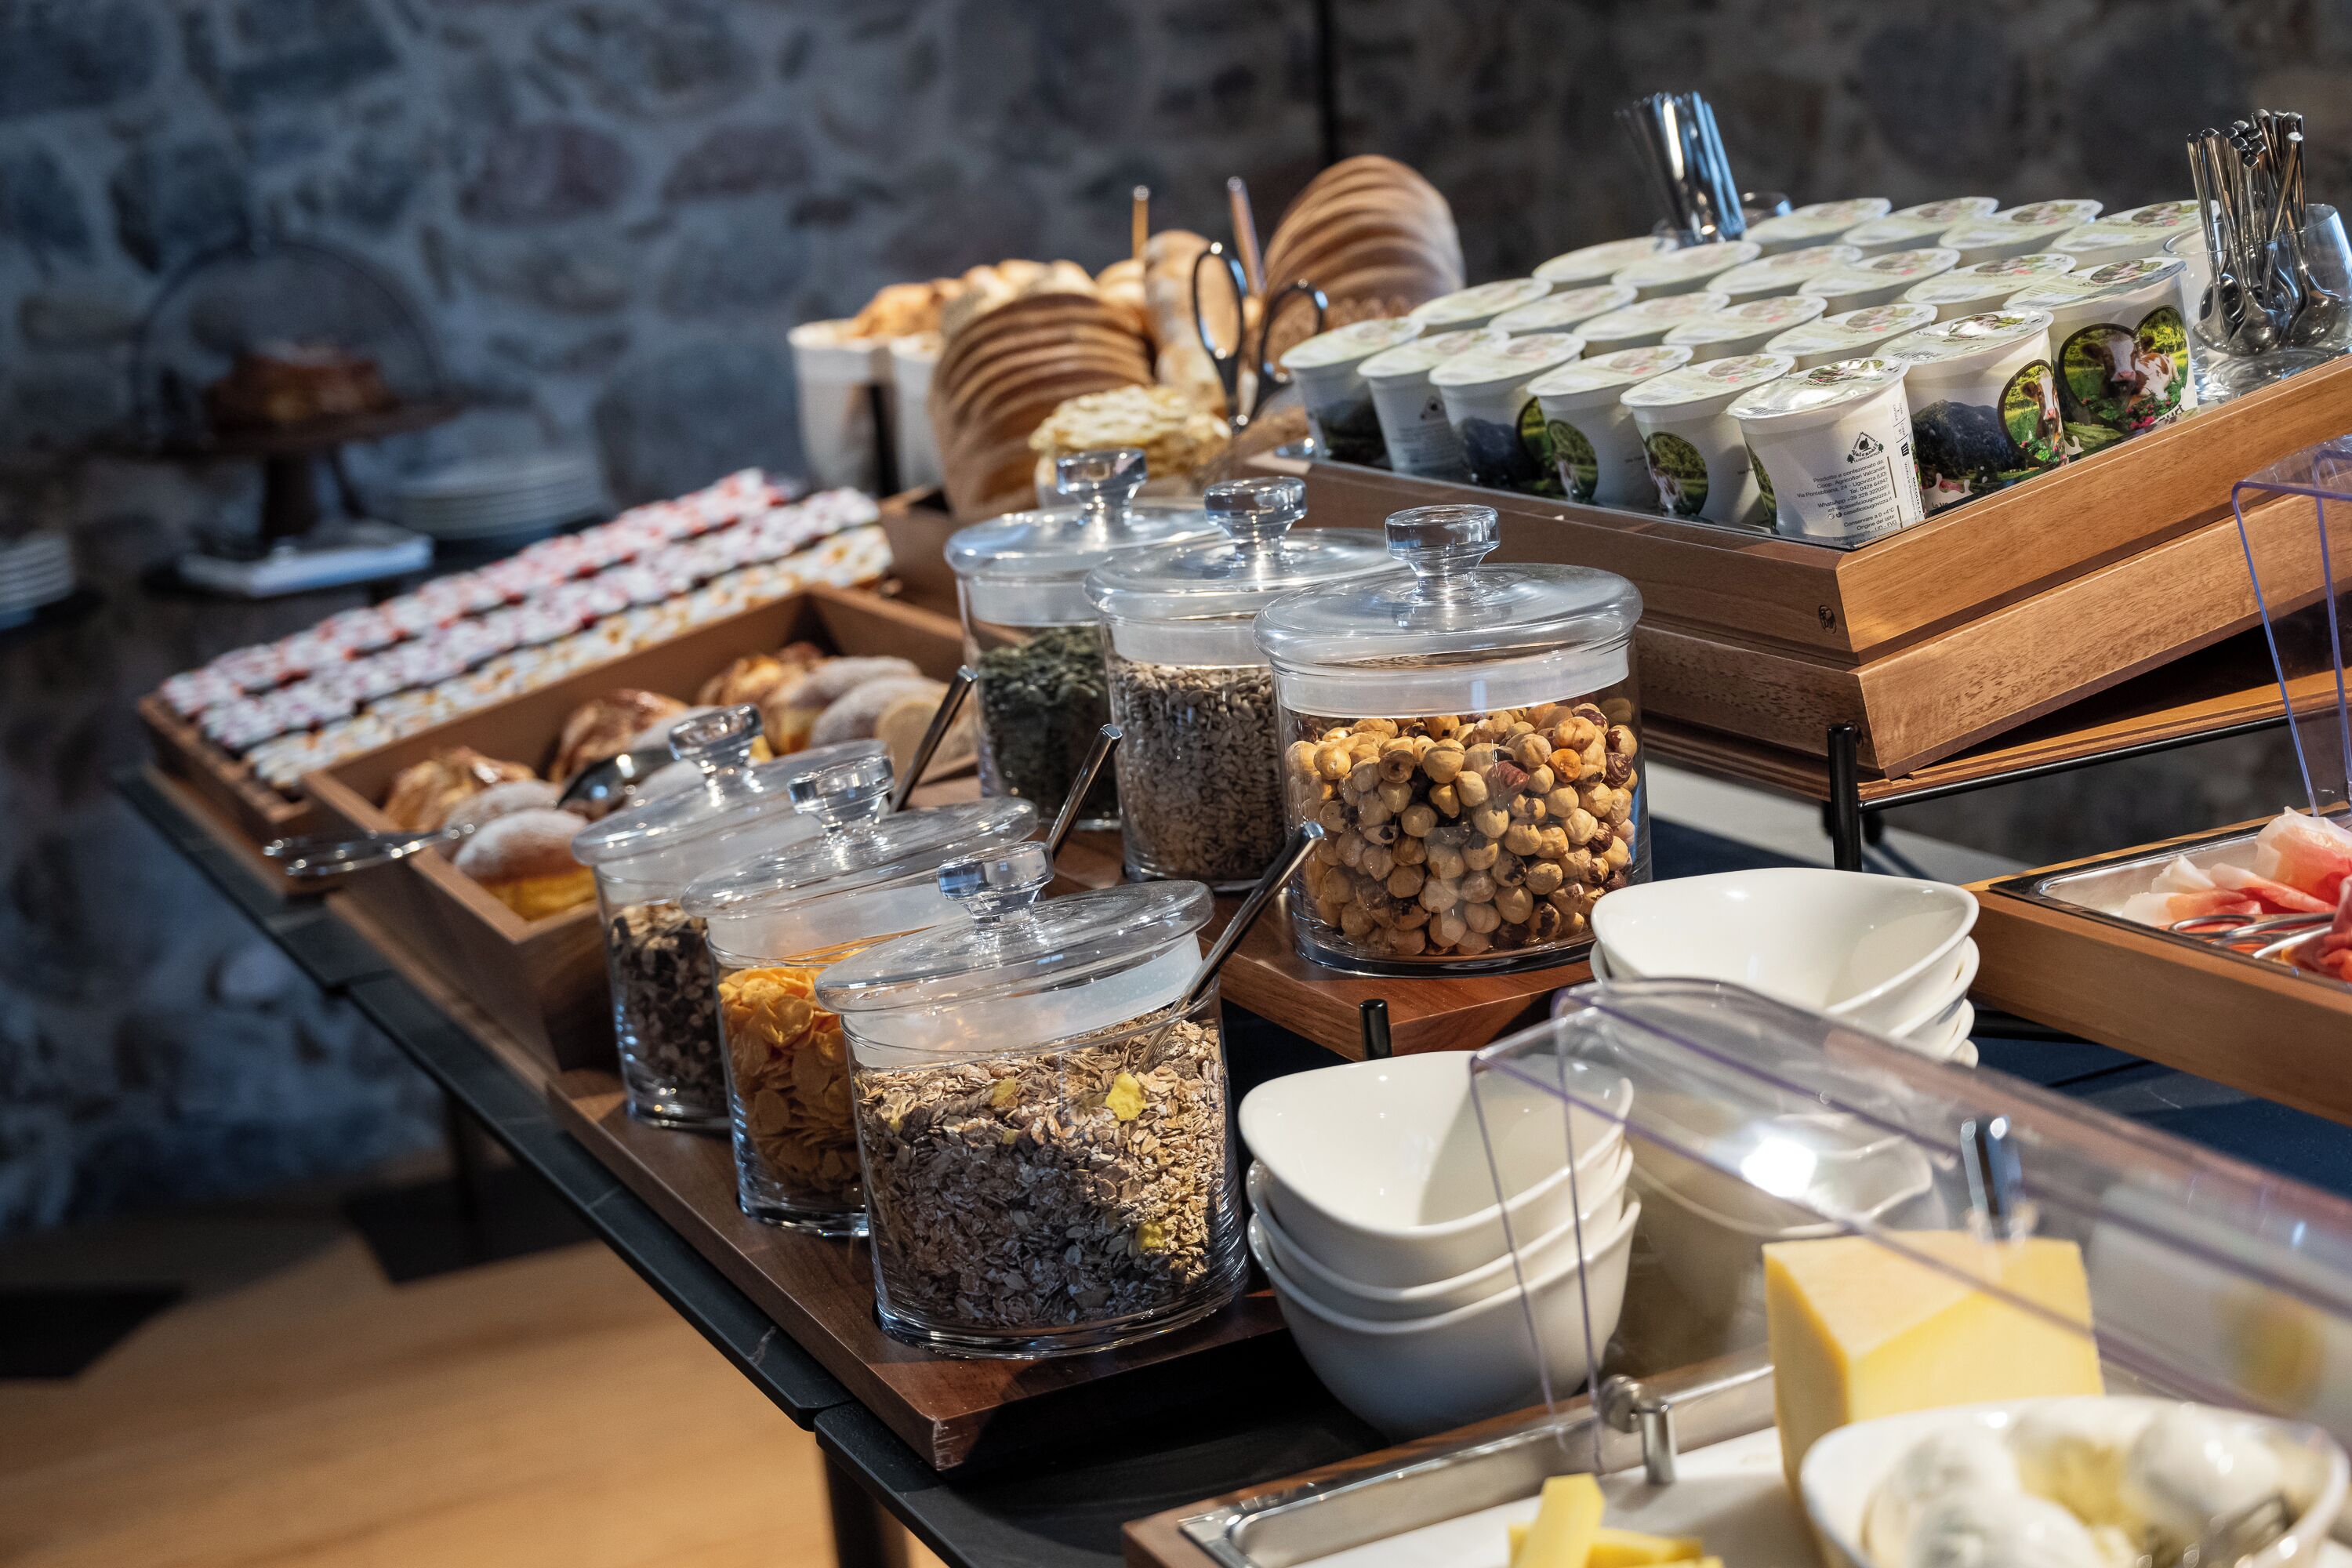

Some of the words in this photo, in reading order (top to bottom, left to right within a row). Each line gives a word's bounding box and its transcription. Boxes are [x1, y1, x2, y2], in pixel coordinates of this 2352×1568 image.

[1813, 474, 1837, 483] Prodotto
[1842, 463, 1876, 476] confezionato
[1835, 472, 1862, 485] Agricoltori
[1863, 465, 1886, 477] Valcanale
[1852, 476, 1876, 488] Ugovizza
[1876, 471, 1888, 480] (UD)
[1860, 482, 1873, 492] 0428
[1817, 499, 1846, 508] WhatsApp
[1844, 516, 1873, 528] Conservare
[1883, 506, 1895, 515] +4°C
[1857, 522, 1875, 531] Origine
